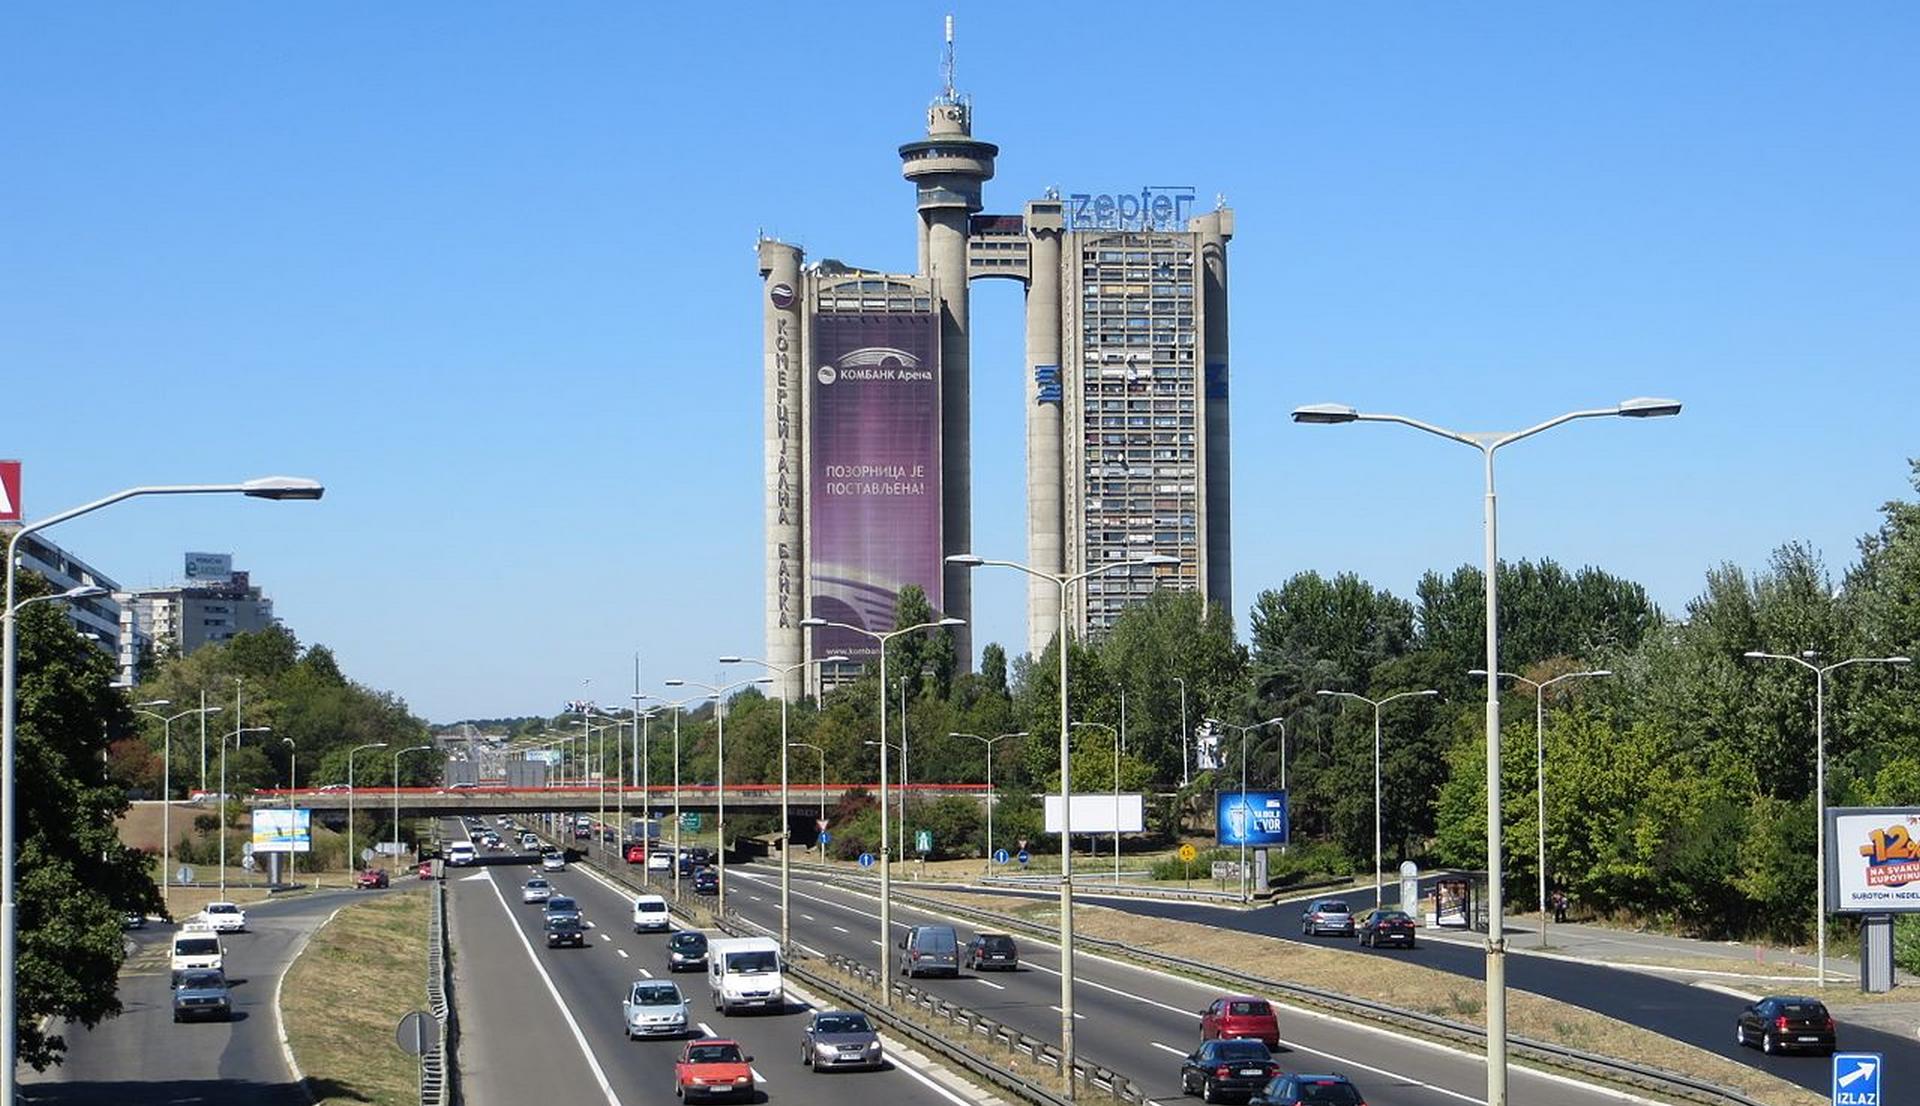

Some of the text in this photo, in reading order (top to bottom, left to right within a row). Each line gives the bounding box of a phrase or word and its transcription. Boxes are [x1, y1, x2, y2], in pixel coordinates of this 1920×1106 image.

[1070, 187, 1194, 229] zepter
[840, 369, 933, 382] КОМБАНК Арена
[776, 318, 790, 628] КОМЕРЦИЈАЛНА БАНКА
[826, 465, 925, 480] ПОЗОРНИЦА ЈЕ
[826, 482, 925, 495] ПОСТАВЉЕНА!
[1870, 863, 1920, 876] NA SVAKU
[1851, 892, 1890, 900] SUBOTOM
[1837, 1092, 1876, 1105] IZLAZ
